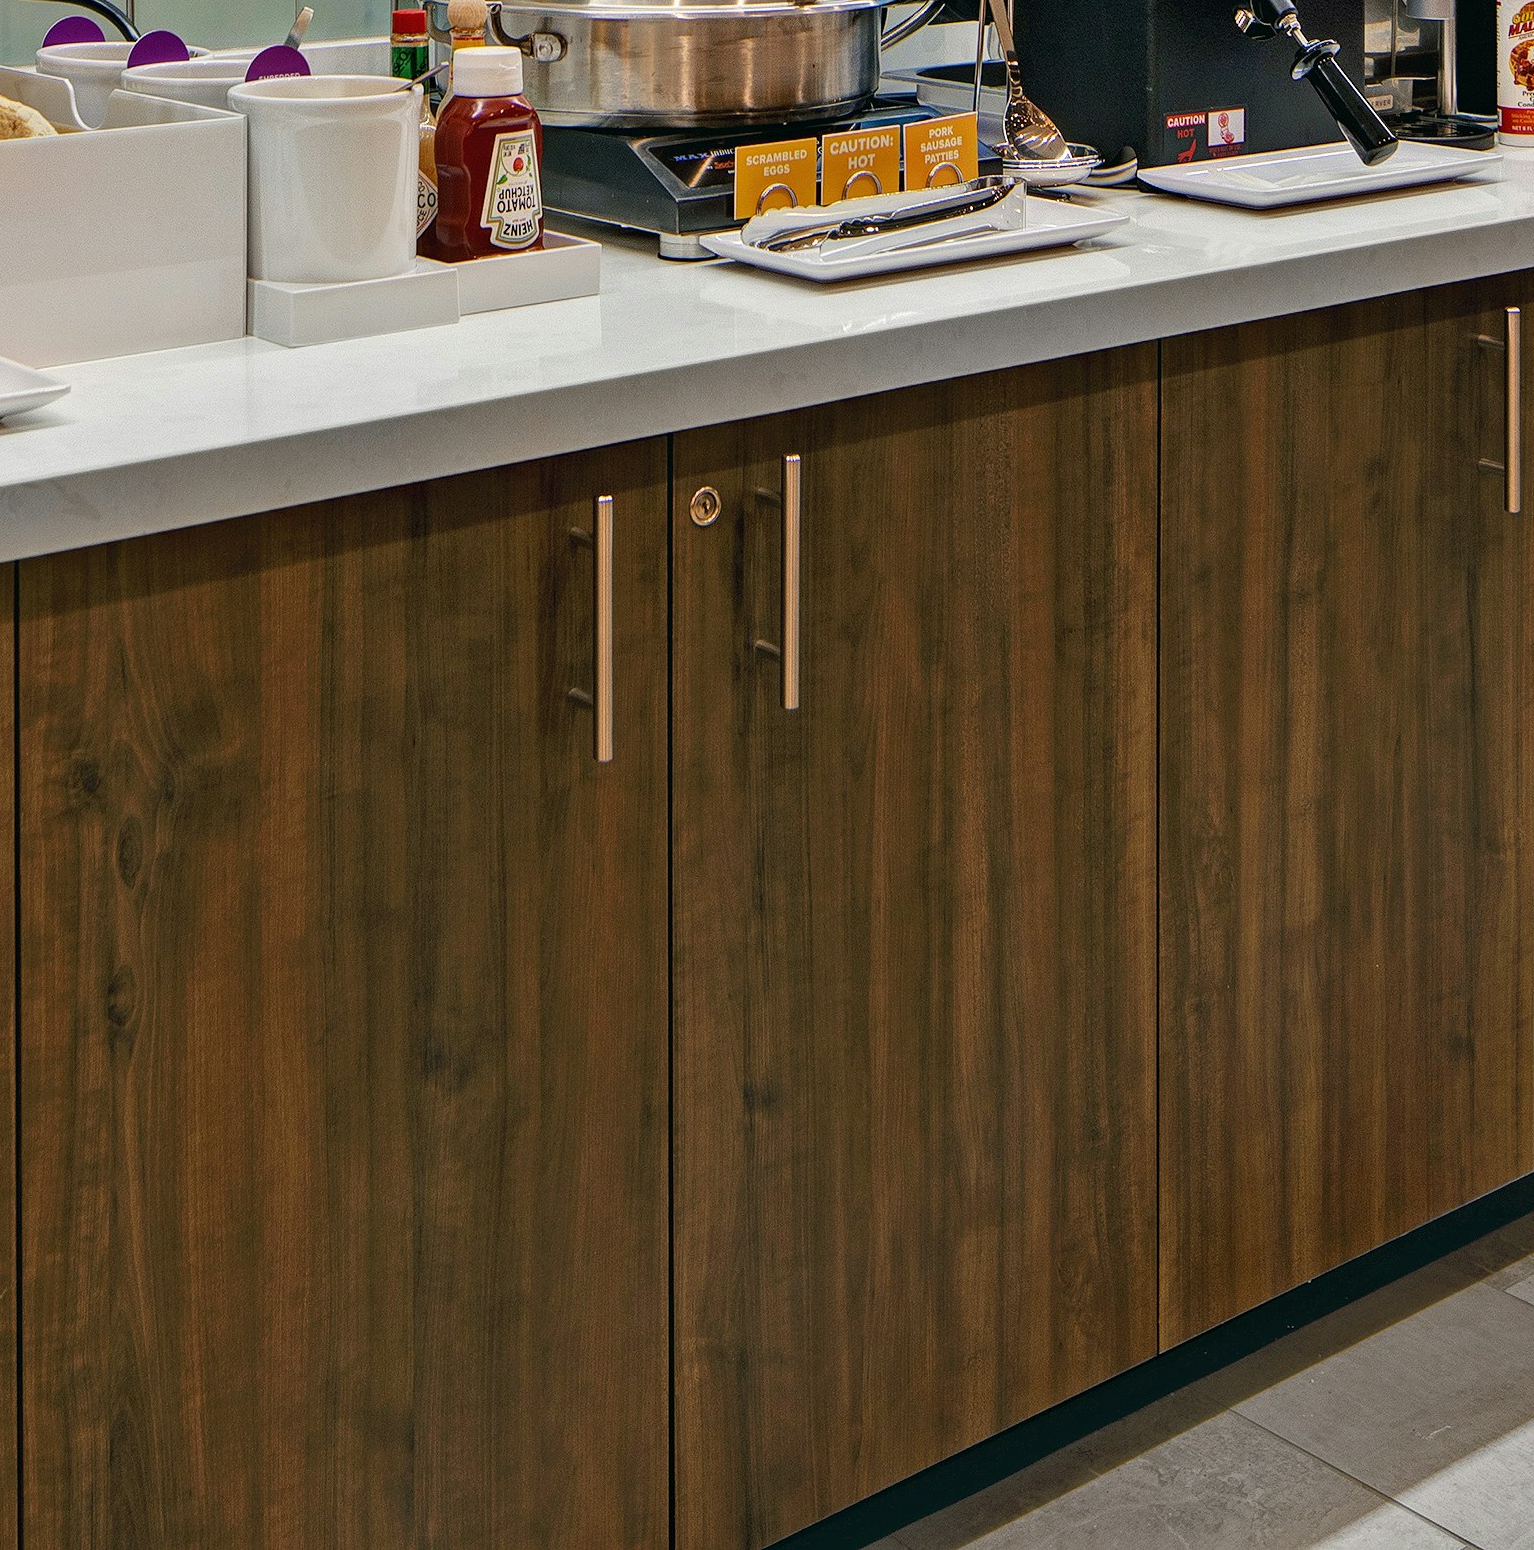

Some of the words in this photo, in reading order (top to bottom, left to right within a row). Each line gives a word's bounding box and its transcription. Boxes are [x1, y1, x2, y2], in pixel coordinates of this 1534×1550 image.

[1167, 114, 1206, 128] CAUTION
[928, 124, 954, 138] PORK
[1176, 128, 1195, 139] HOT
[829, 133, 894, 156] CAUTION:
[920, 136, 963, 153] SAUSAGE
[745, 149, 807, 167] SCRAMBLED
[848, 154, 876, 170] HOT
[924, 149, 960, 164] PATTIES
[763, 164, 791, 177] EGGS
[498, 184, 534, 200] KETCHUP
[496, 194, 536, 214] TOMATO
[502, 219, 534, 237] HEINZ
